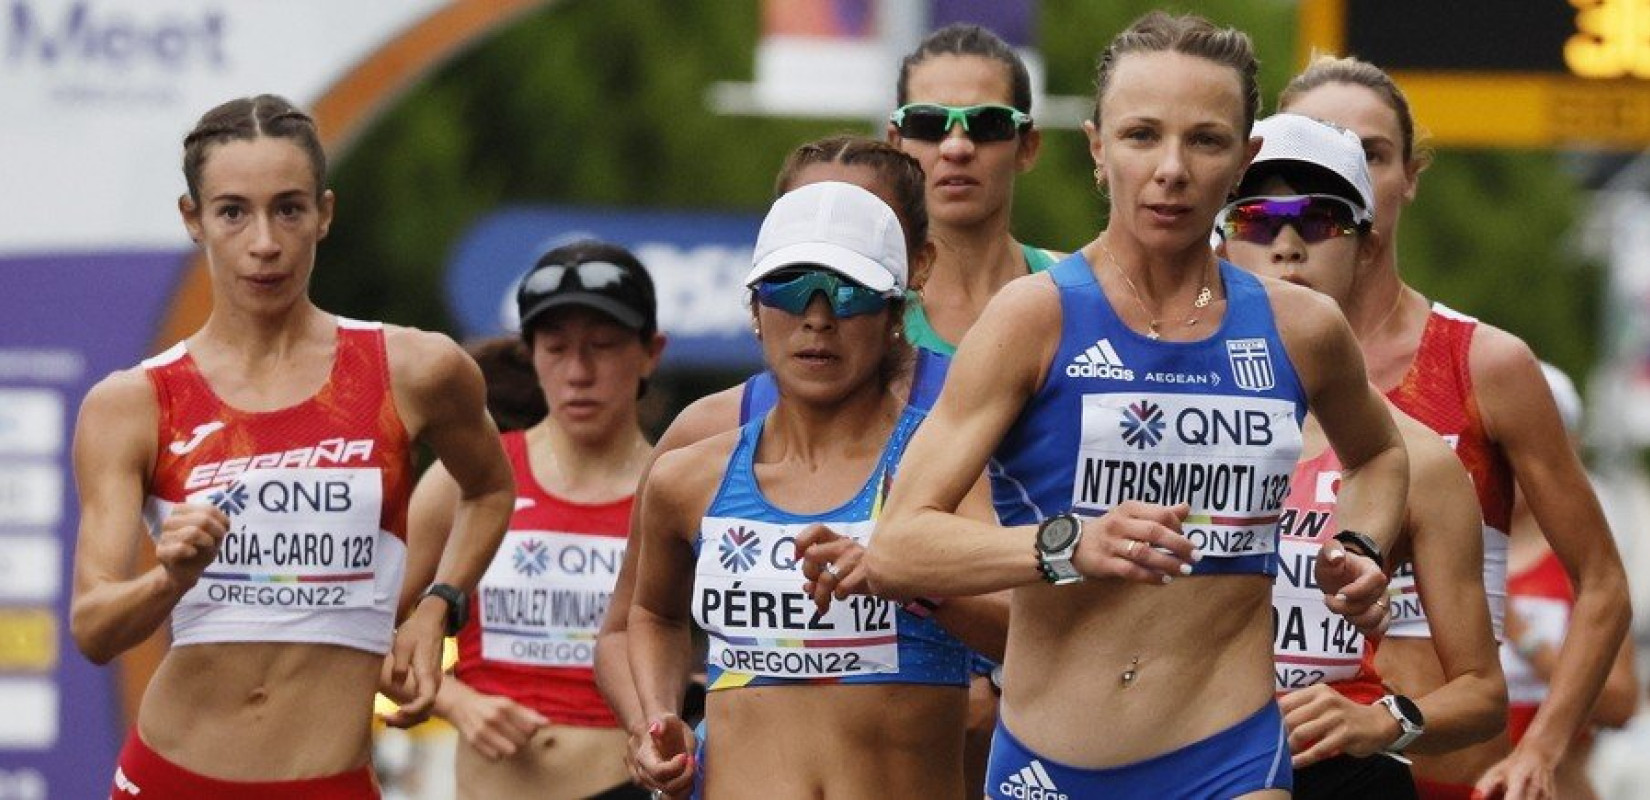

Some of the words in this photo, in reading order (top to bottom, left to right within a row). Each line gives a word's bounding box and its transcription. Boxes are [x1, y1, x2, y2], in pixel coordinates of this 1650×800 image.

[1066, 361, 1135, 381] adidas
[1145, 372, 1208, 384] AEGEAN
[1176, 407, 1273, 446] QNB
[184, 437, 374, 490] ESPAÑA
[258, 480, 352, 513] QNB
[1081, 457, 1255, 513] NTRISMPIOTI
[217, 525, 334, 567] CÍA-CARO
[342, 536, 374, 568] 123
[558, 545, 626, 576] QN
[207, 583, 347, 607] OREGON22
[702, 580, 834, 630] PÉREZ
[850, 596, 891, 632] 122
[511, 641, 591, 662] OREGO
[1320, 617, 1358, 654] 142
[721, 648, 862, 675] OREGON22
